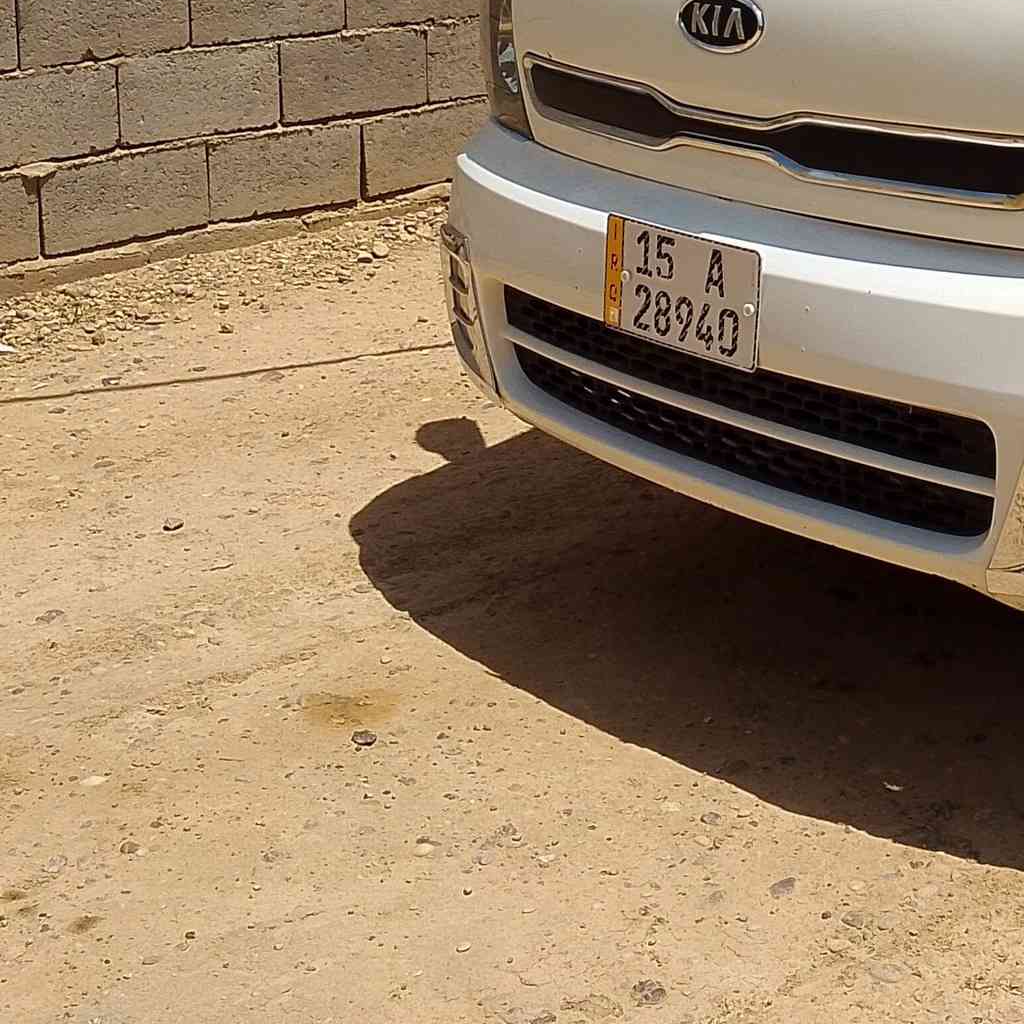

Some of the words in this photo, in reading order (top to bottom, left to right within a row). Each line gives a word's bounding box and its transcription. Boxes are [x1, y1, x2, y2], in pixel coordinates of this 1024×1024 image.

[690, 1, 746, 41] KIA
[635, 230, 676, 280] 15
[704, 248, 725, 298] A
[632, 283, 740, 358] 28940
